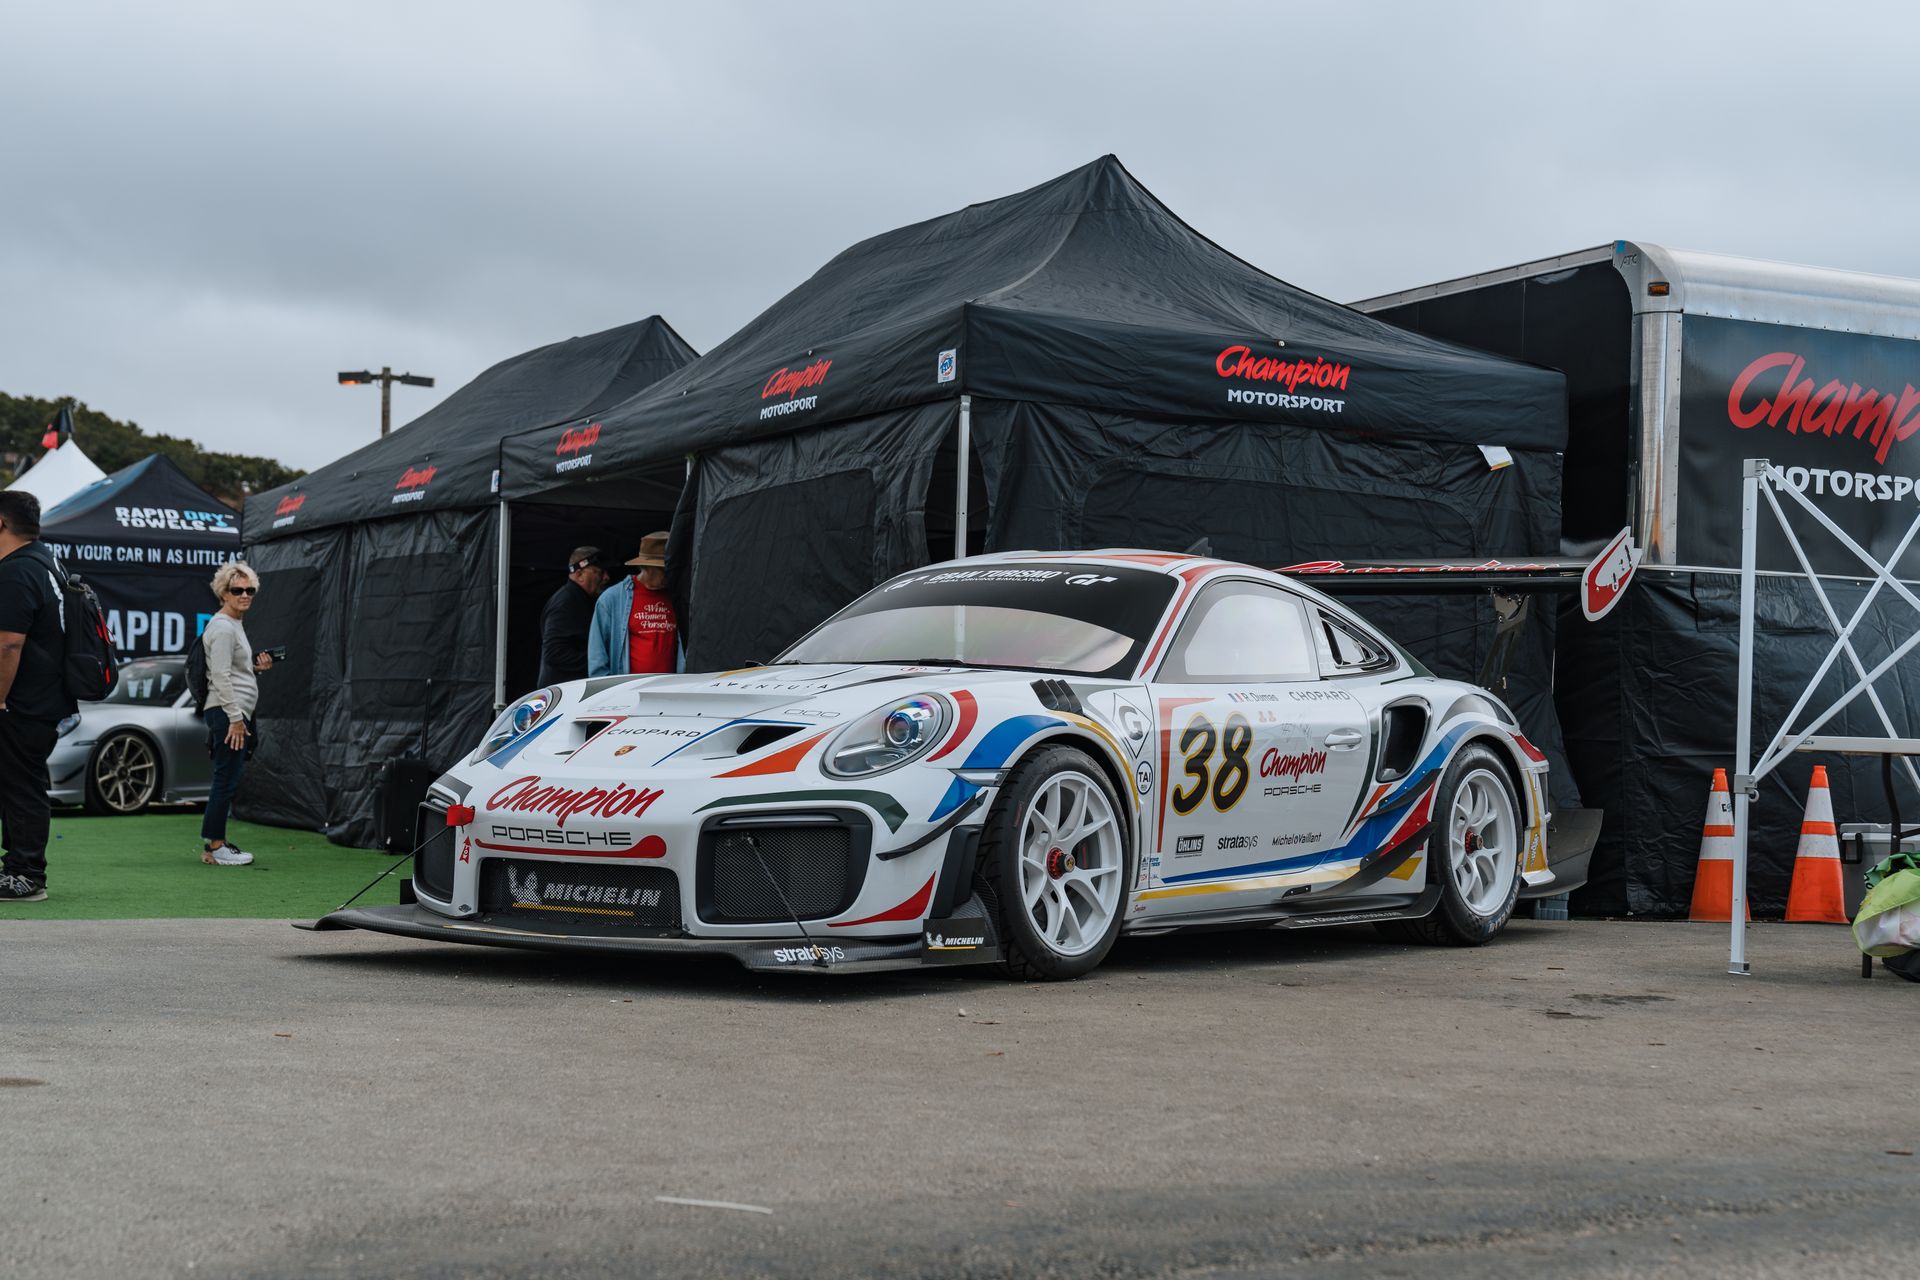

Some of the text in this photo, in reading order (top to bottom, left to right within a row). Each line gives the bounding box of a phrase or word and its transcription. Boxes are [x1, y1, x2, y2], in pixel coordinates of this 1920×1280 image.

[761, 358, 832, 399] Champion
[1215, 345, 1350, 394] Champion
[760, 395, 818, 420] MOTORSPORT
[1227, 389, 1345, 413] MOTORSPORT
[1728, 351, 1920, 465] Champ
[556, 454, 592, 473] MOTORSPORT
[1759, 465, 1920, 502] MOTORSP
[115, 506, 226, 524] RAPID DRY
[116, 517, 207, 531] TOWELS
[75, 544, 112, 561] YOUR
[116, 547, 143, 562] CAR
[148, 548, 161, 563] IN
[166, 549, 183, 564] AS
[187, 549, 224, 566] LITTLE
[105, 609, 186, 652] APID
[1289, 690, 1351, 701] CHOPARD
[608, 728, 701, 738] CHOPARD
[1172, 712, 1253, 816] 38
[1260, 746, 1327, 783] Champion
[485, 775, 665, 828] Champion
[1264, 783, 1322, 797] PORSCHE
[492, 825, 633, 846] PORSCHE
[1217, 834, 1259, 850] stratasys
[543, 882, 662, 907] MICHELIN
[944, 936, 984, 946] MICHELIN
